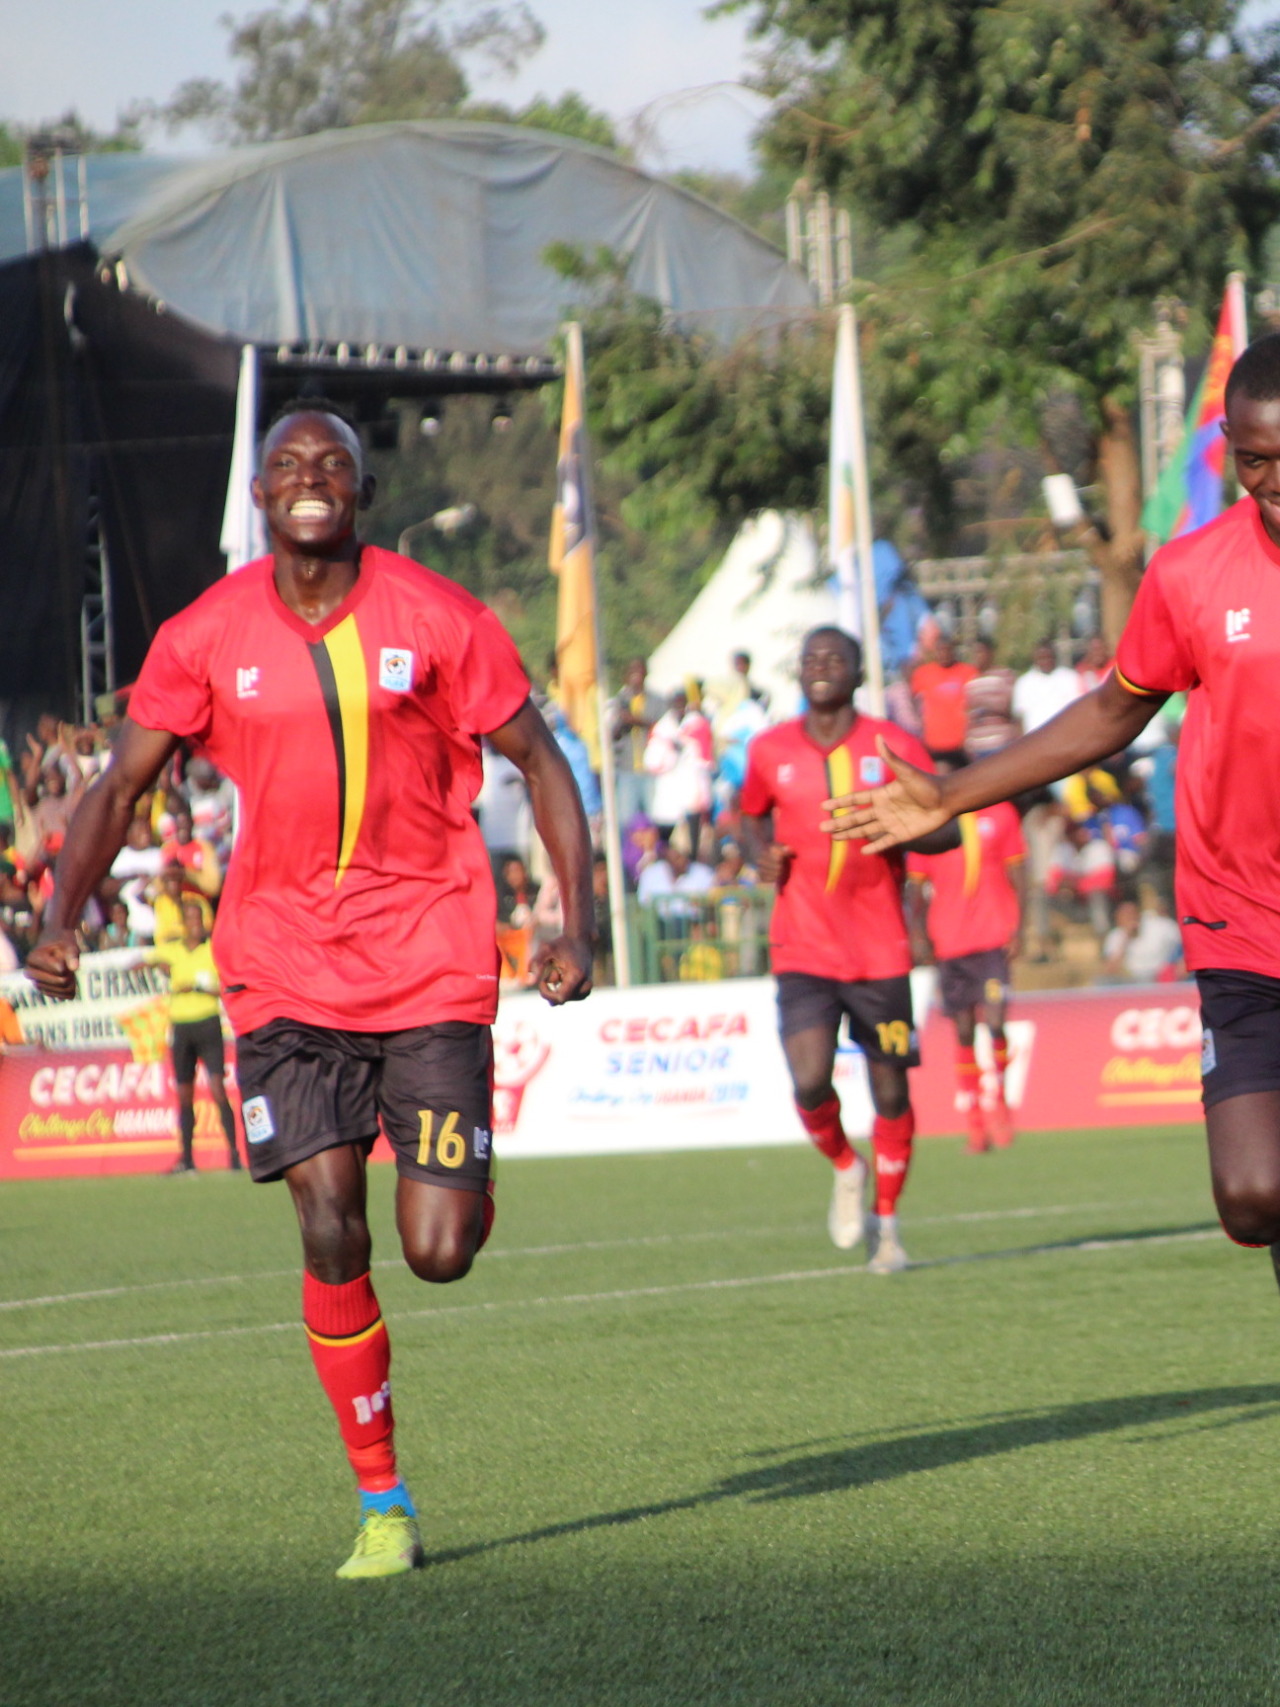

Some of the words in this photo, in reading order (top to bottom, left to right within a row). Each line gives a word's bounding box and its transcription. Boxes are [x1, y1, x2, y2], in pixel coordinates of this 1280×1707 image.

[599, 1011, 749, 1044] CECAFA
[875, 1019, 911, 1057] 19
[606, 1046, 733, 1076] SENIOR
[29, 1061, 164, 1107] CECAFA
[417, 1109, 466, 1169] 16
